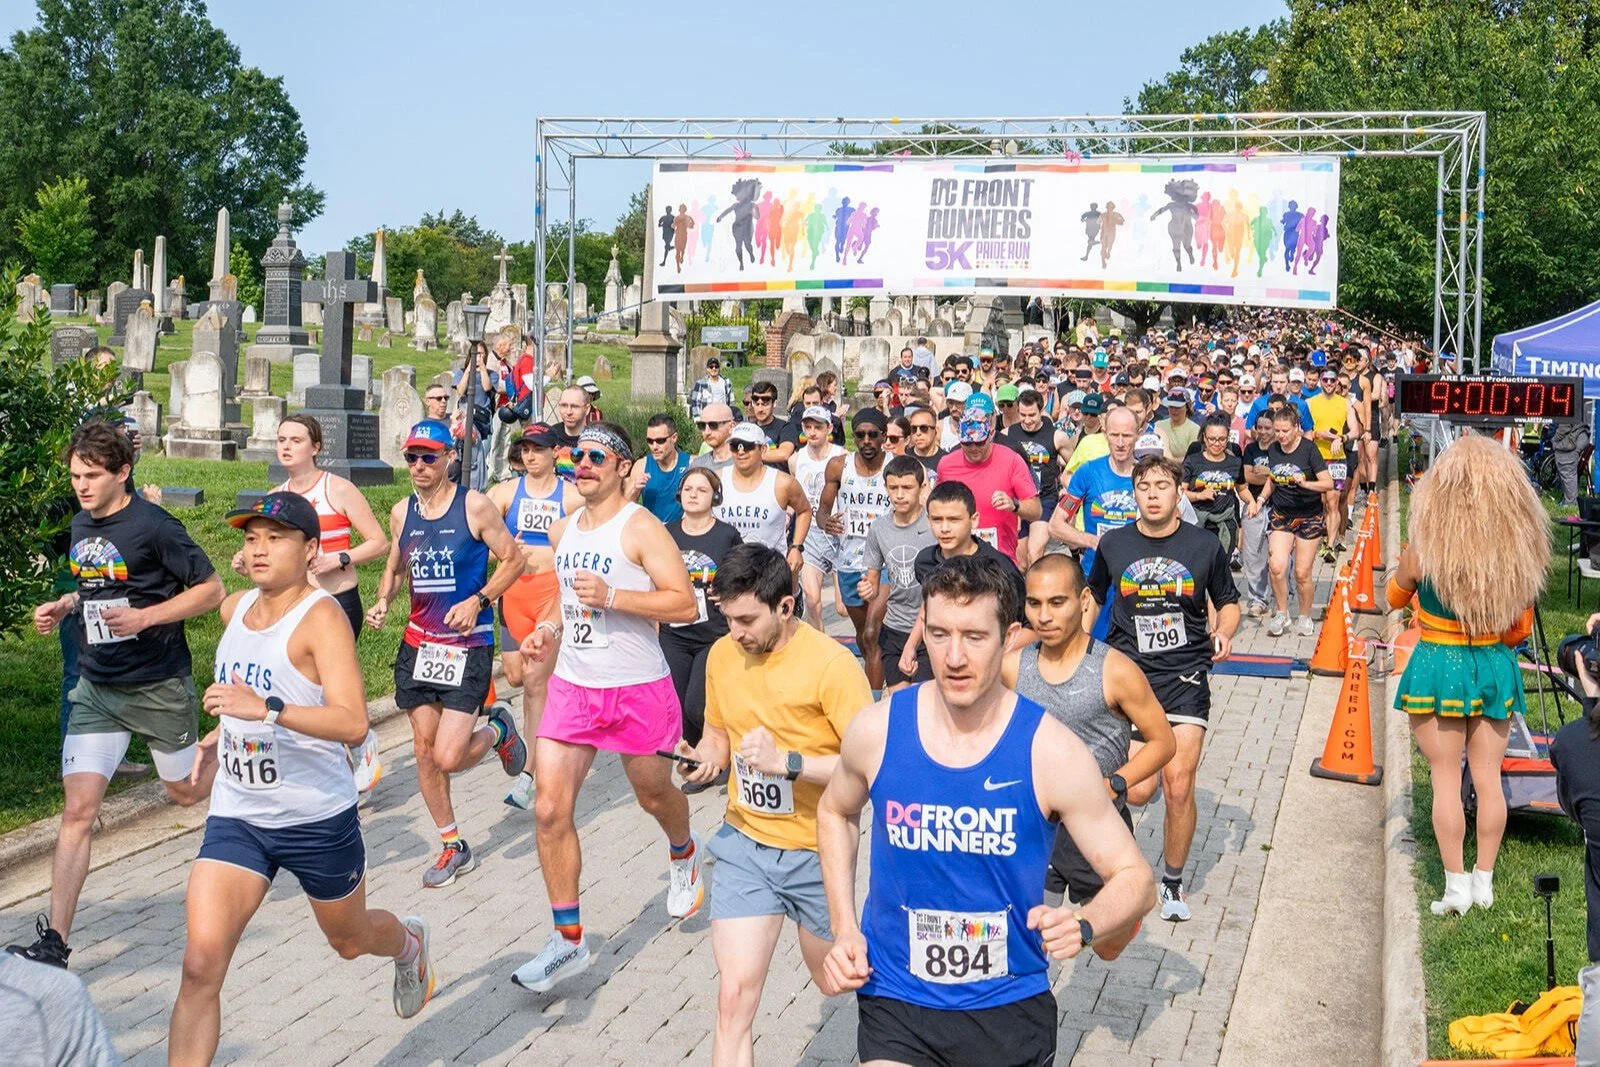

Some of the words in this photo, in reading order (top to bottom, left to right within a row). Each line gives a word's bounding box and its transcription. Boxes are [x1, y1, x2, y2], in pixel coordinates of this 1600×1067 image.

[930, 178, 958, 206] DC
[961, 179, 1035, 207] FRONT
[927, 208, 1032, 239] RUNNERS
[925, 241, 975, 271] 5K
[976, 241, 1006, 260] PRIDE
[1008, 241, 1030, 260] RUN
[1440, 374, 1458, 382] ARE
[1460, 375, 1485, 383] Event
[1486, 375, 1539, 384] Productions
[842, 492, 891, 508] PACERS
[524, 513, 553, 530] 920
[721, 505, 769, 520] PACERS
[412, 563, 429, 578] dc
[433, 561, 455, 578] tri
[557, 552, 613, 575] PACERS
[573, 622, 593, 644] 32
[1145, 628, 1179, 649] 799
[421, 660, 456, 682] 326
[1341, 661, 1363, 762] AREEP.COM
[222, 751, 277, 785] 1416
[742, 778, 782, 810] 569
[887, 822, 1018, 857] RUNNERS
[544, 948, 578, 977] BROOKS
[925, 943, 992, 978] 894
